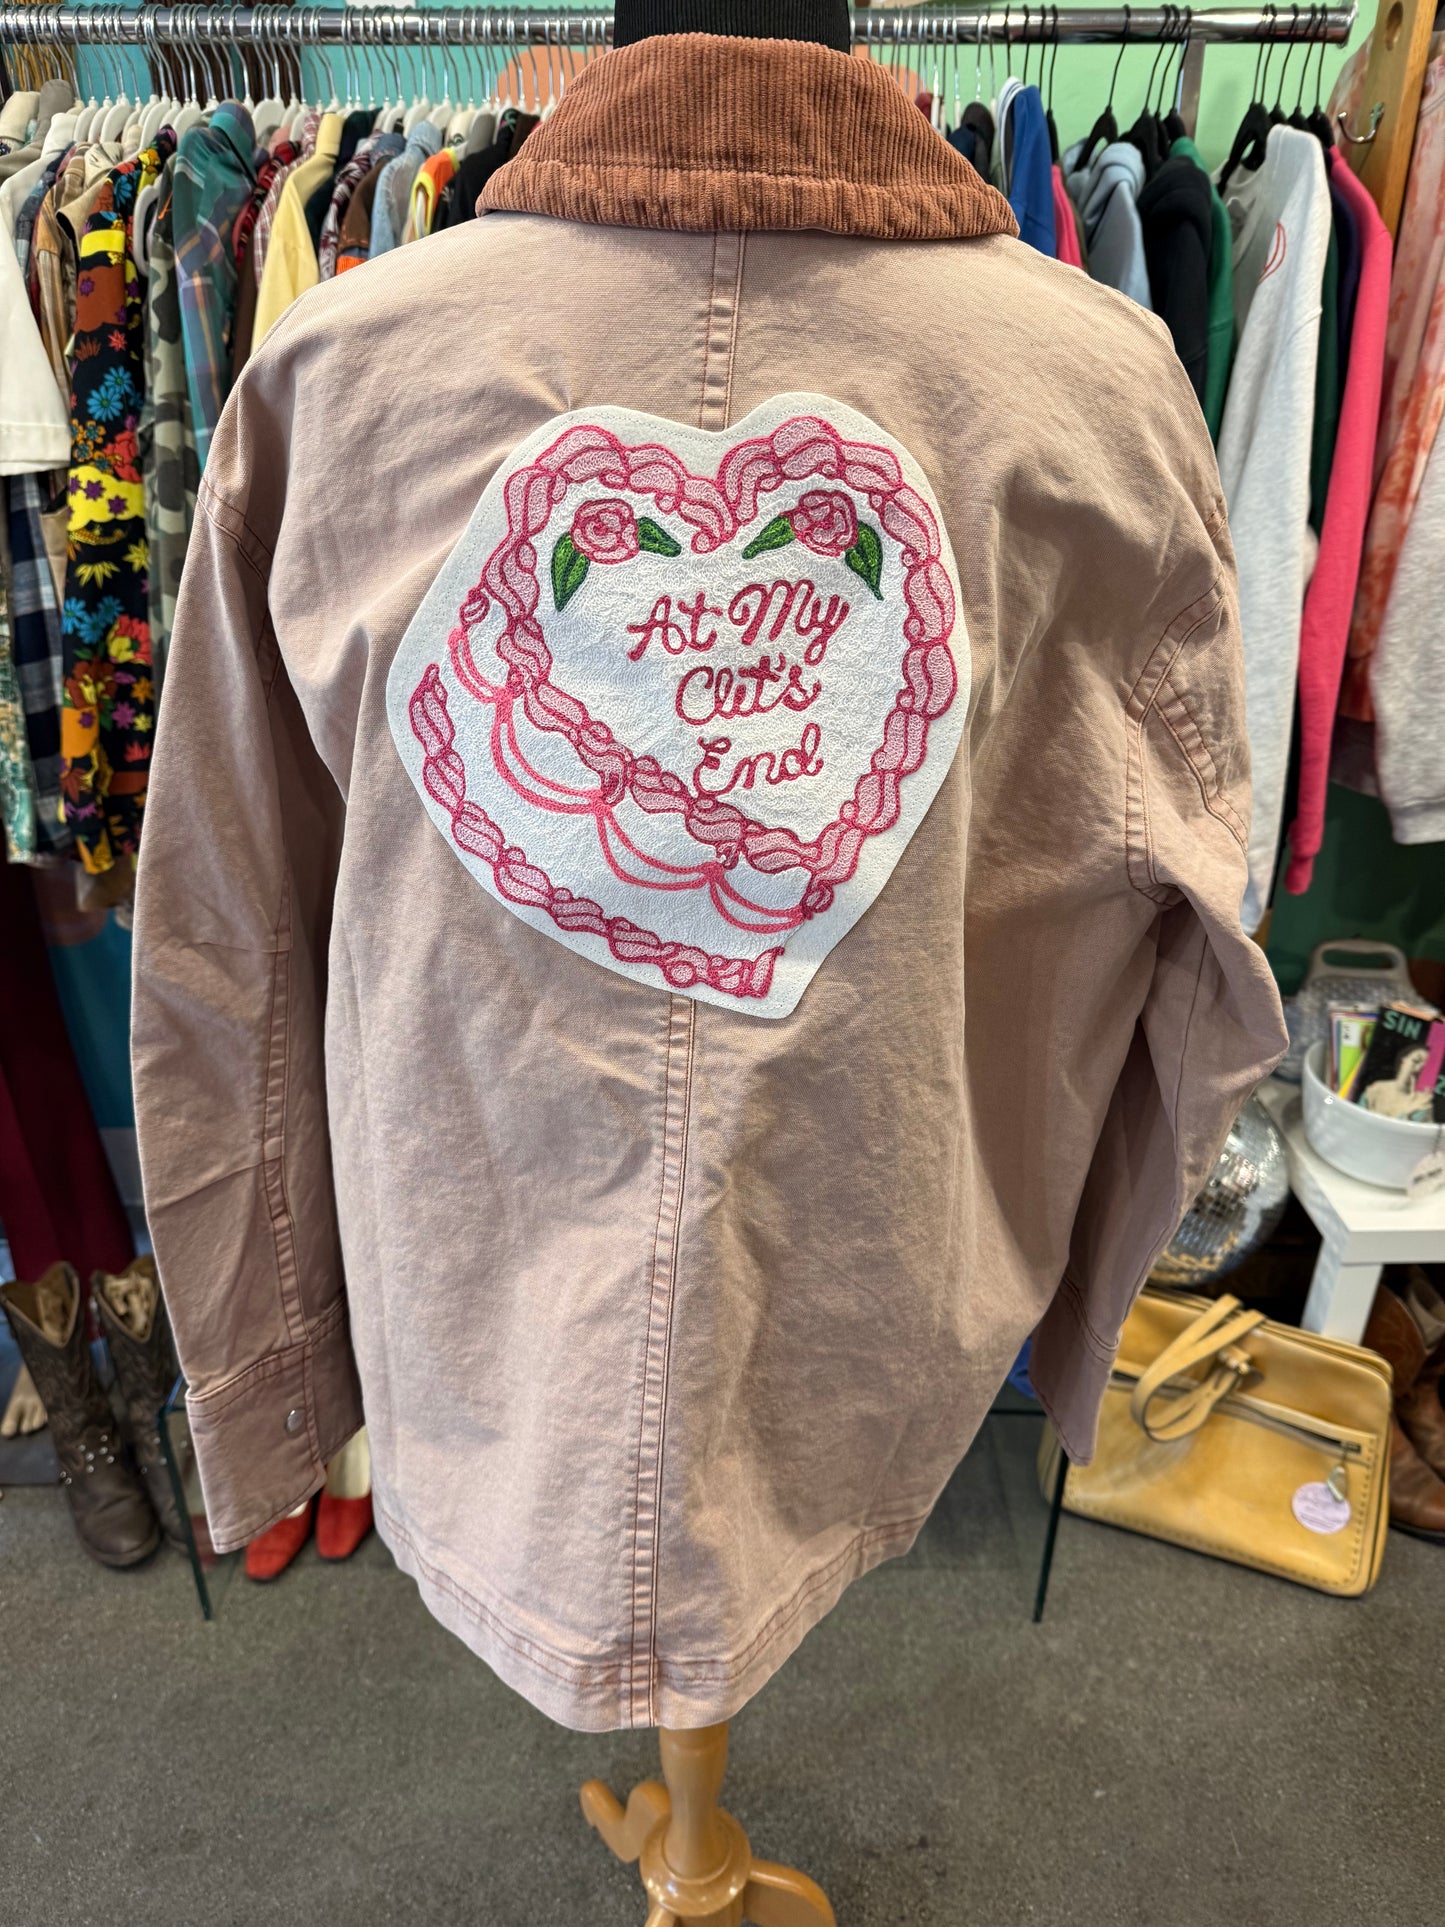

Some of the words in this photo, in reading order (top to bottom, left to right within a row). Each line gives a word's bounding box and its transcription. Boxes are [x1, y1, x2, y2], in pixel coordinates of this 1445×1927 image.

[627, 591, 723, 661] At
[728, 579, 850, 666] My
[675, 652, 822, 725] Clit's
[693, 723, 824, 796] End
[1383, 1010, 1422, 1040] SIN
